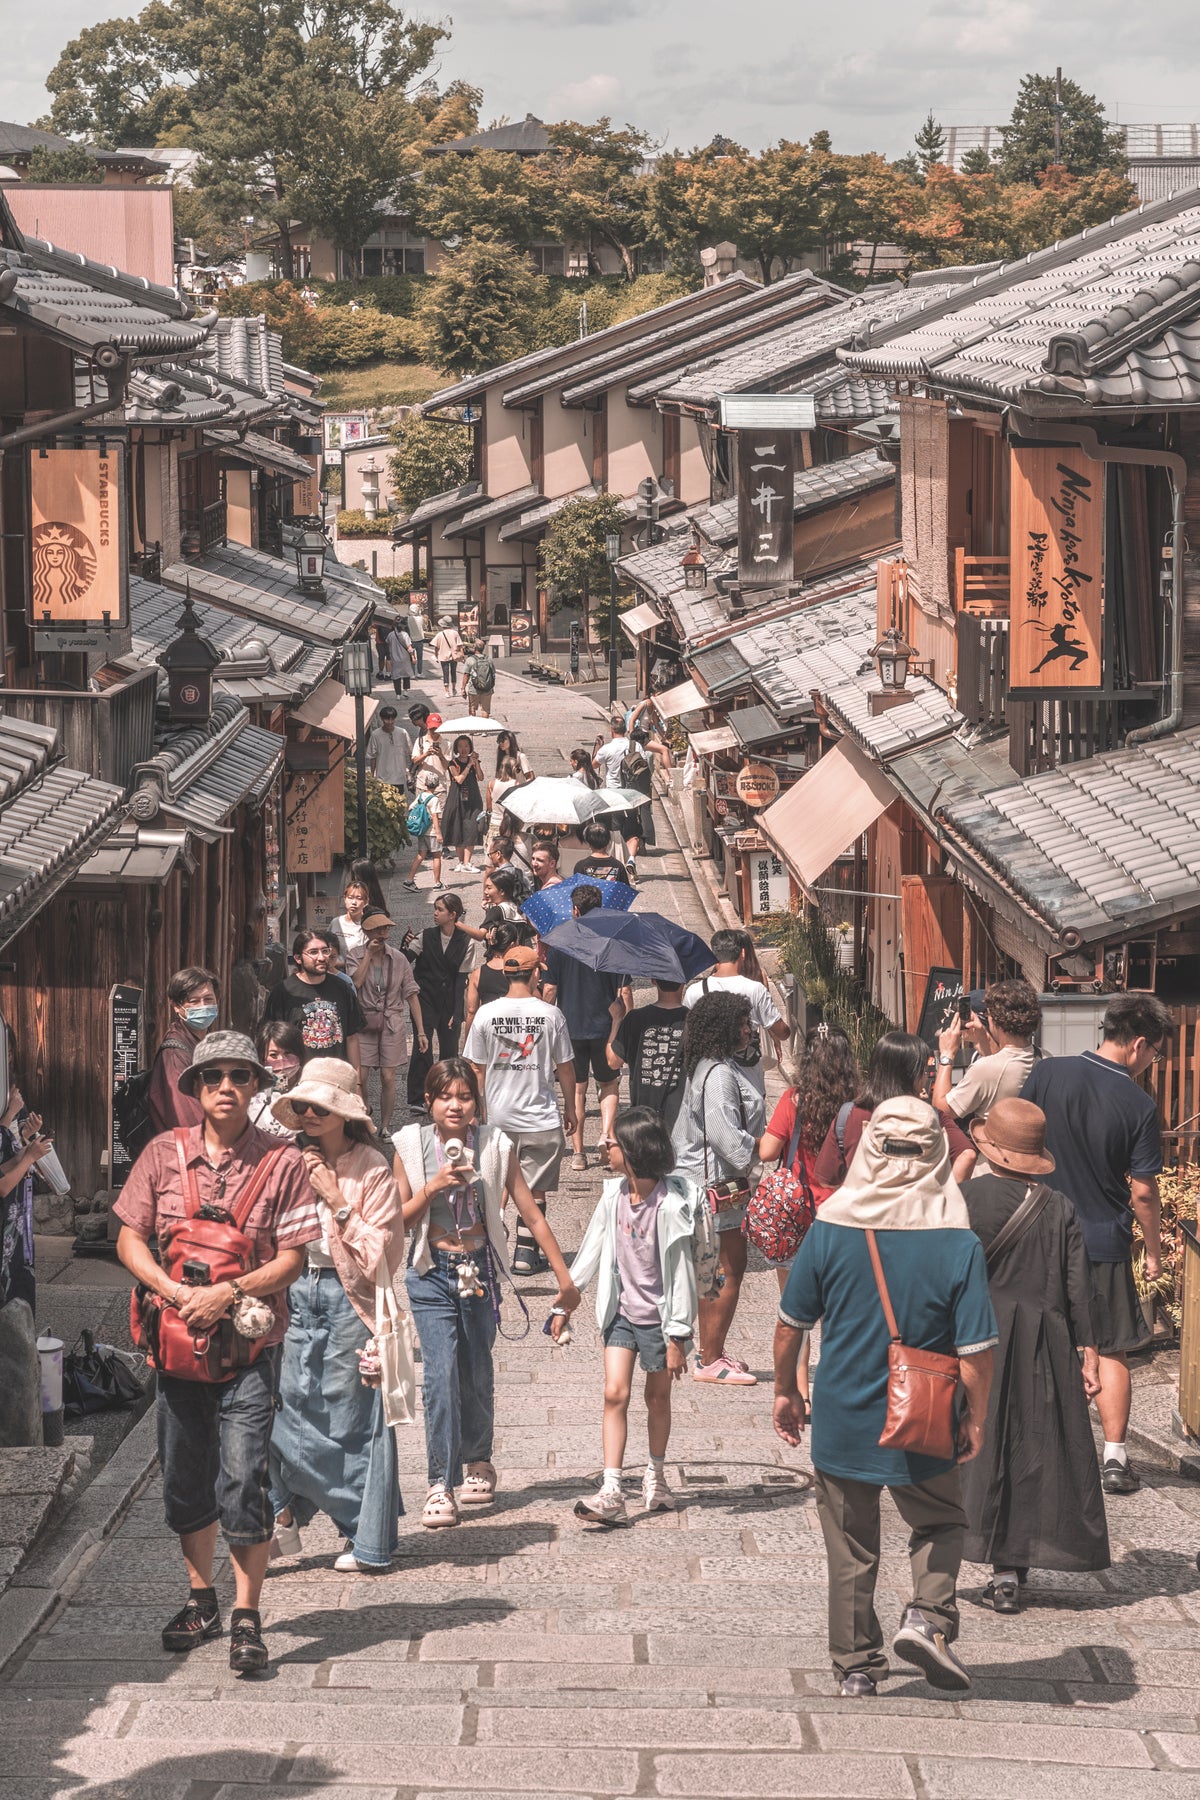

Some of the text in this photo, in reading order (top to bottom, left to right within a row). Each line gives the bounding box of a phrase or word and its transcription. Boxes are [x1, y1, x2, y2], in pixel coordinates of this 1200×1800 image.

[99, 462, 110, 547] STARBUCKS
[750, 444, 787, 563] 二井三
[1050, 462, 1092, 532] Ninja
[1052, 567, 1093, 622] Kyoto
[491, 1016, 546, 1026] AIR WILL TAKE
[494, 1025, 513, 1034] YOU
